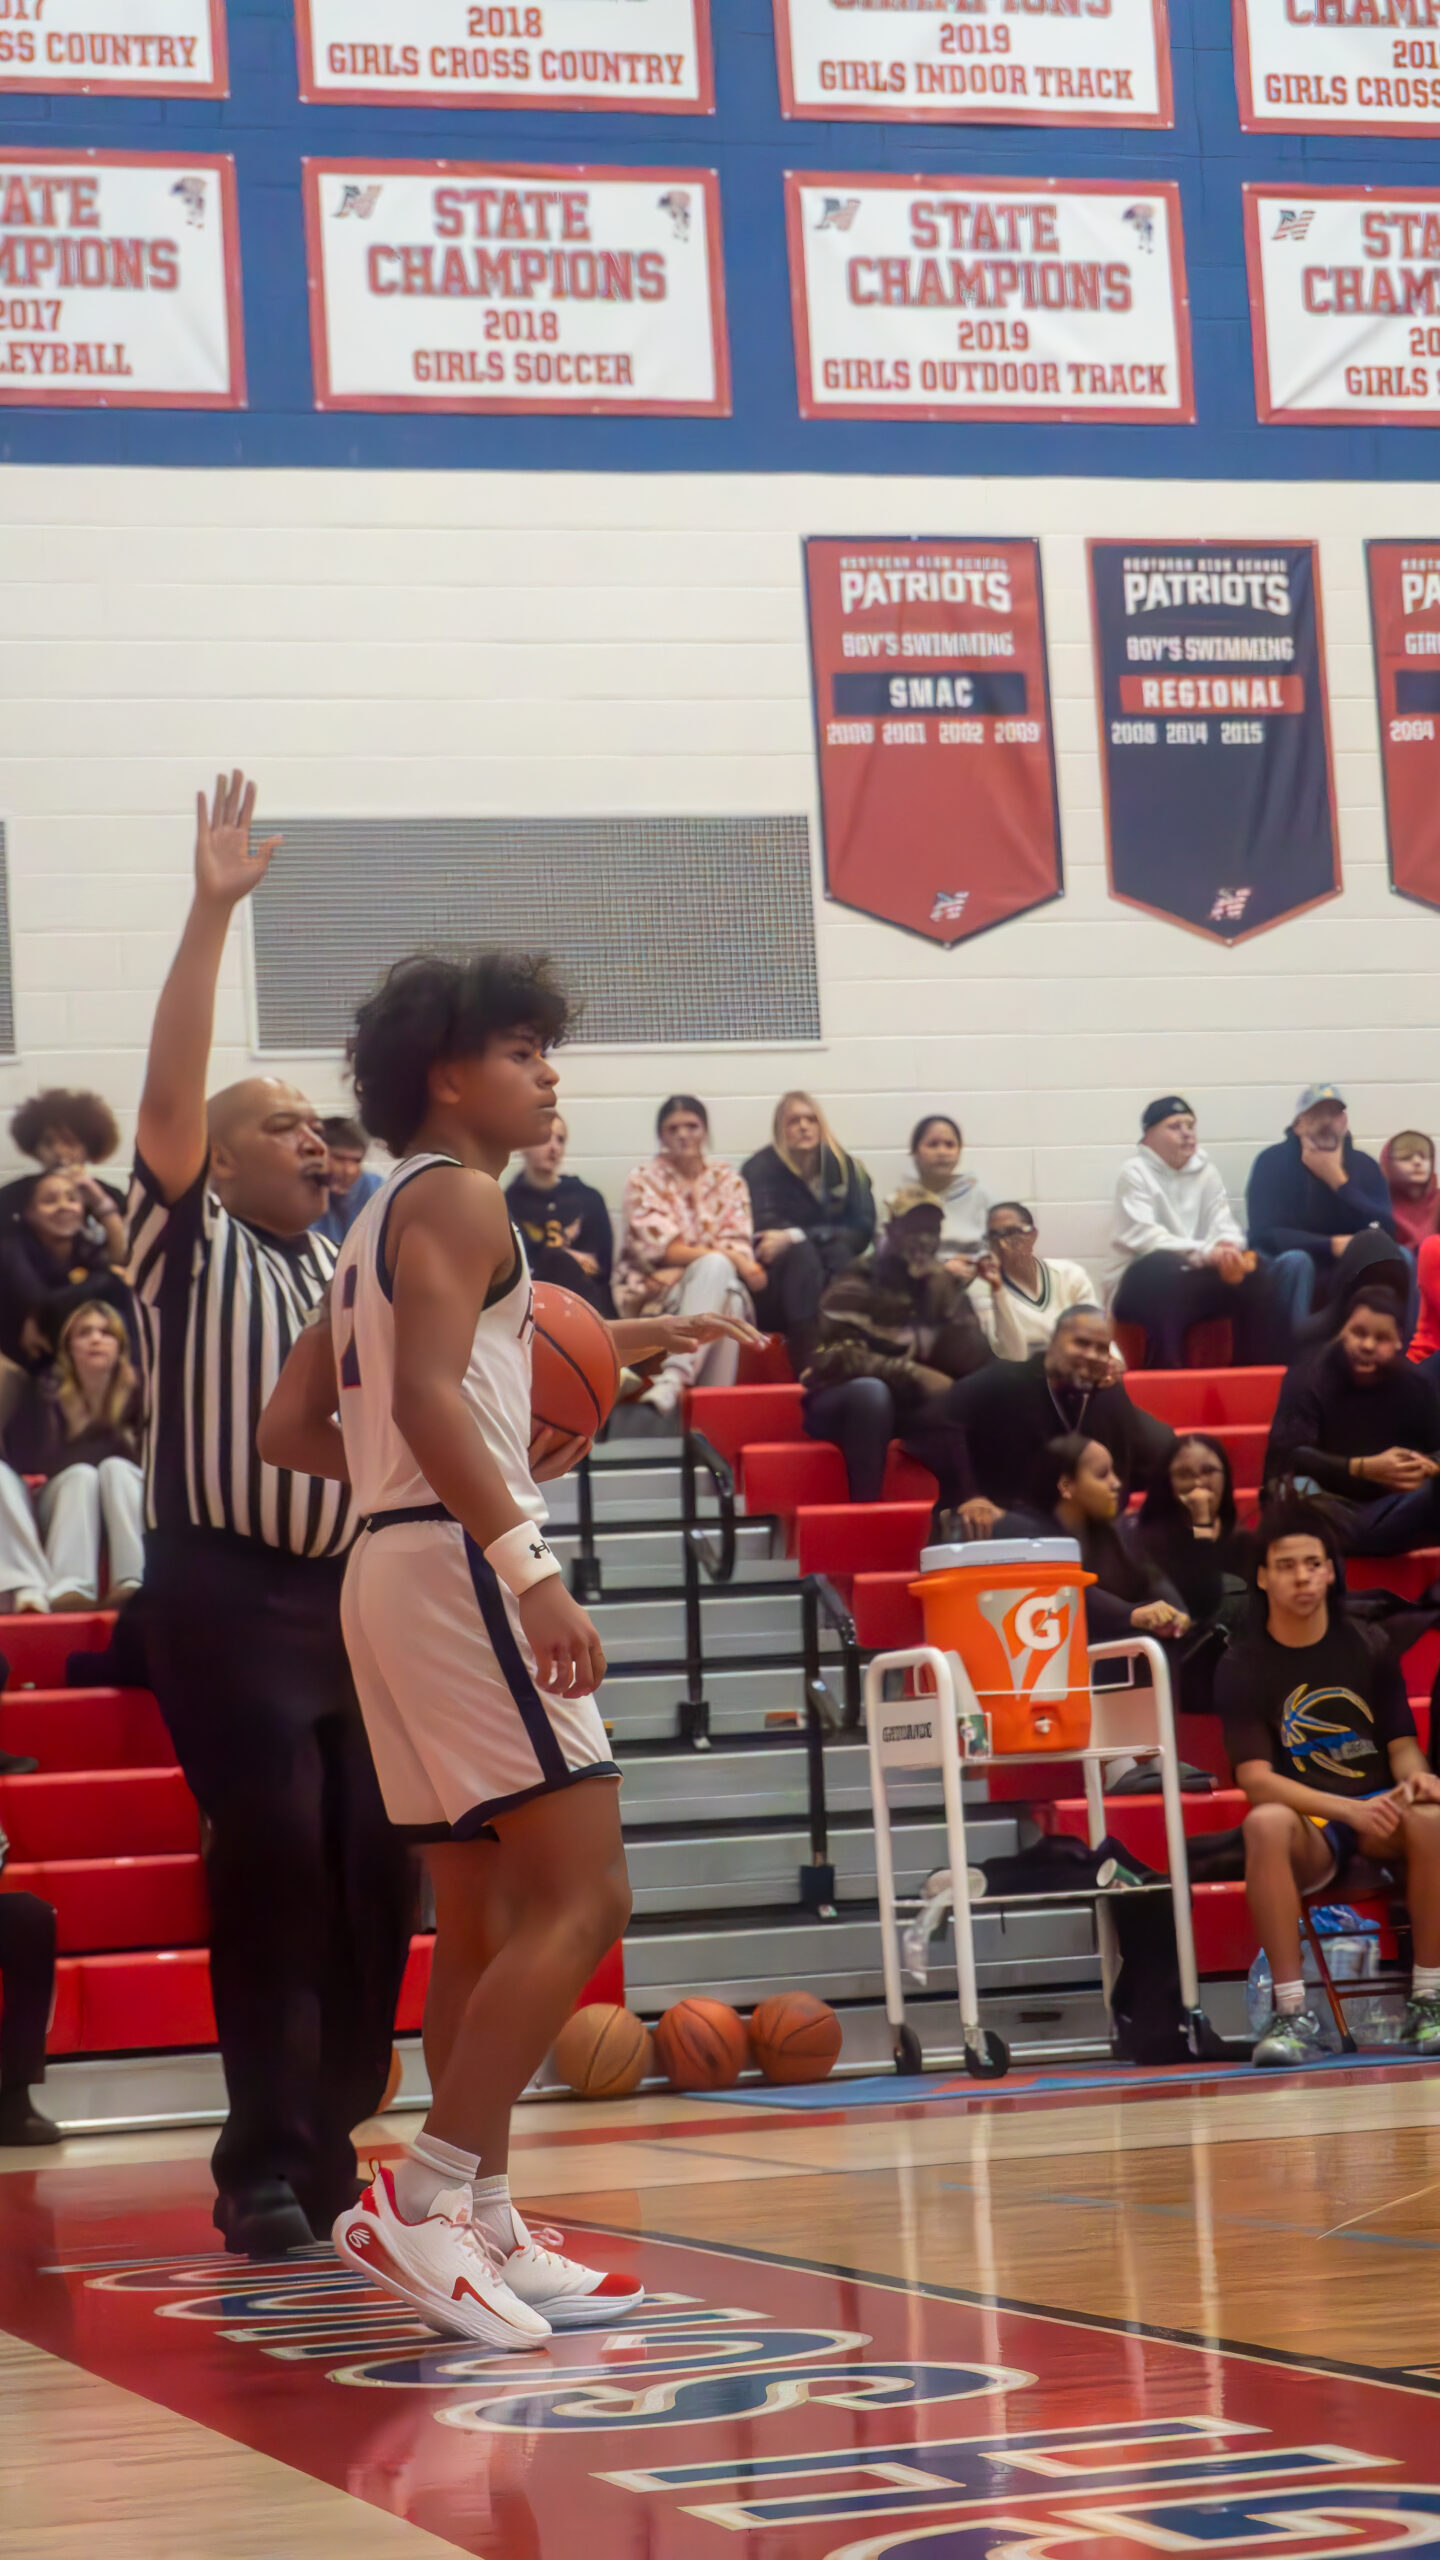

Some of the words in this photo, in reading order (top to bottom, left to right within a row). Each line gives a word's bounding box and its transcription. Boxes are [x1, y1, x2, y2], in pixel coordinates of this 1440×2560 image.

[467, 7, 543, 37] 2018
[939, 23, 1011, 54] 2019
[46, 32, 198, 67] COUNTRY
[327, 43, 419, 77] GIRLS
[430, 46, 529, 79] CROSS
[541, 50, 684, 85] COUNTRY
[1393, 40, 1440, 69] 201
[818, 60, 906, 93] GIRLS
[915, 63, 1028, 95] INDOOR
[1035, 67, 1134, 100] TRACK
[1265, 73, 1348, 105] GIRLS
[0, 174, 100, 227] ATE
[432, 188, 591, 242] STATE
[909, 201, 1060, 254] STATE
[366, 244, 668, 302] CHAMPIONS
[846, 256, 1133, 313] CHAMPIONS
[1301, 264, 1440, 316] CHAM
[484, 310, 559, 342] 2018
[957, 320, 1029, 351] 2019
[413, 350, 504, 383] GIRLS
[514, 352, 634, 385] SOCCER
[822, 358, 910, 391] GIRLS
[920, 360, 1060, 394] OUTDOOR
[1066, 363, 1167, 395] TRACK
[1344, 365, 1428, 397] GIRLS
[840, 570, 1013, 615] PATRIOTS
[1124, 572, 1291, 617] PATRIOTS
[842, 631, 899, 657] BOY'S
[901, 630, 1015, 657] SWIMMING
[1126, 635, 1183, 662] BOY'S
[1184, 636, 1295, 662] SWIMMING
[888, 677, 974, 709] SMAC
[1141, 678, 1284, 709] REGIONAL
[1015, 1596, 1060, 1651] G
